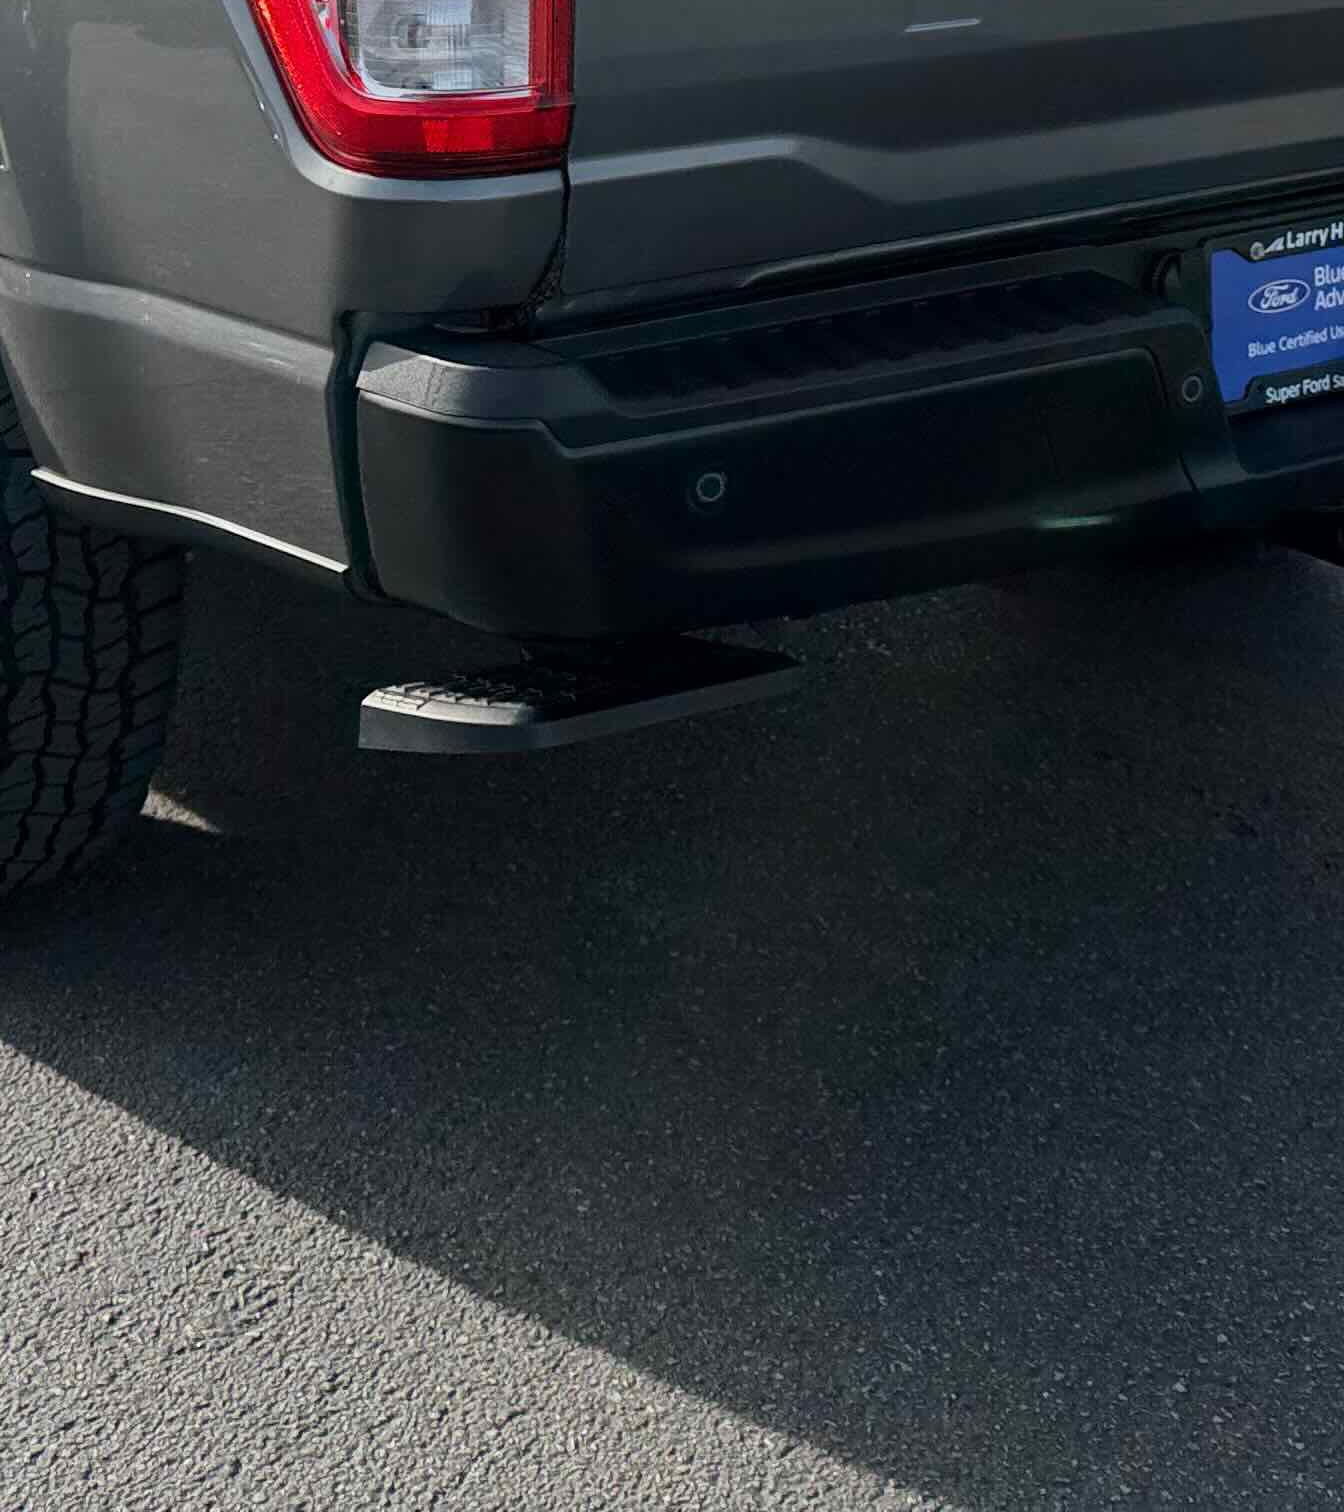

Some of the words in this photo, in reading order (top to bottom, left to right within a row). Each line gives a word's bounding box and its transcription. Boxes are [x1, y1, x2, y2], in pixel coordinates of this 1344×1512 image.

[1287, 227, 1328, 249] Larry
[1330, 220, 1343, 240] H
[1260, 286, 1299, 310] Ford
[1247, 341, 1277, 358] Blue
[1279, 327, 1329, 352] Certified
[1265, 384, 1301, 404] Super
[1302, 372, 1331, 395] Ford
